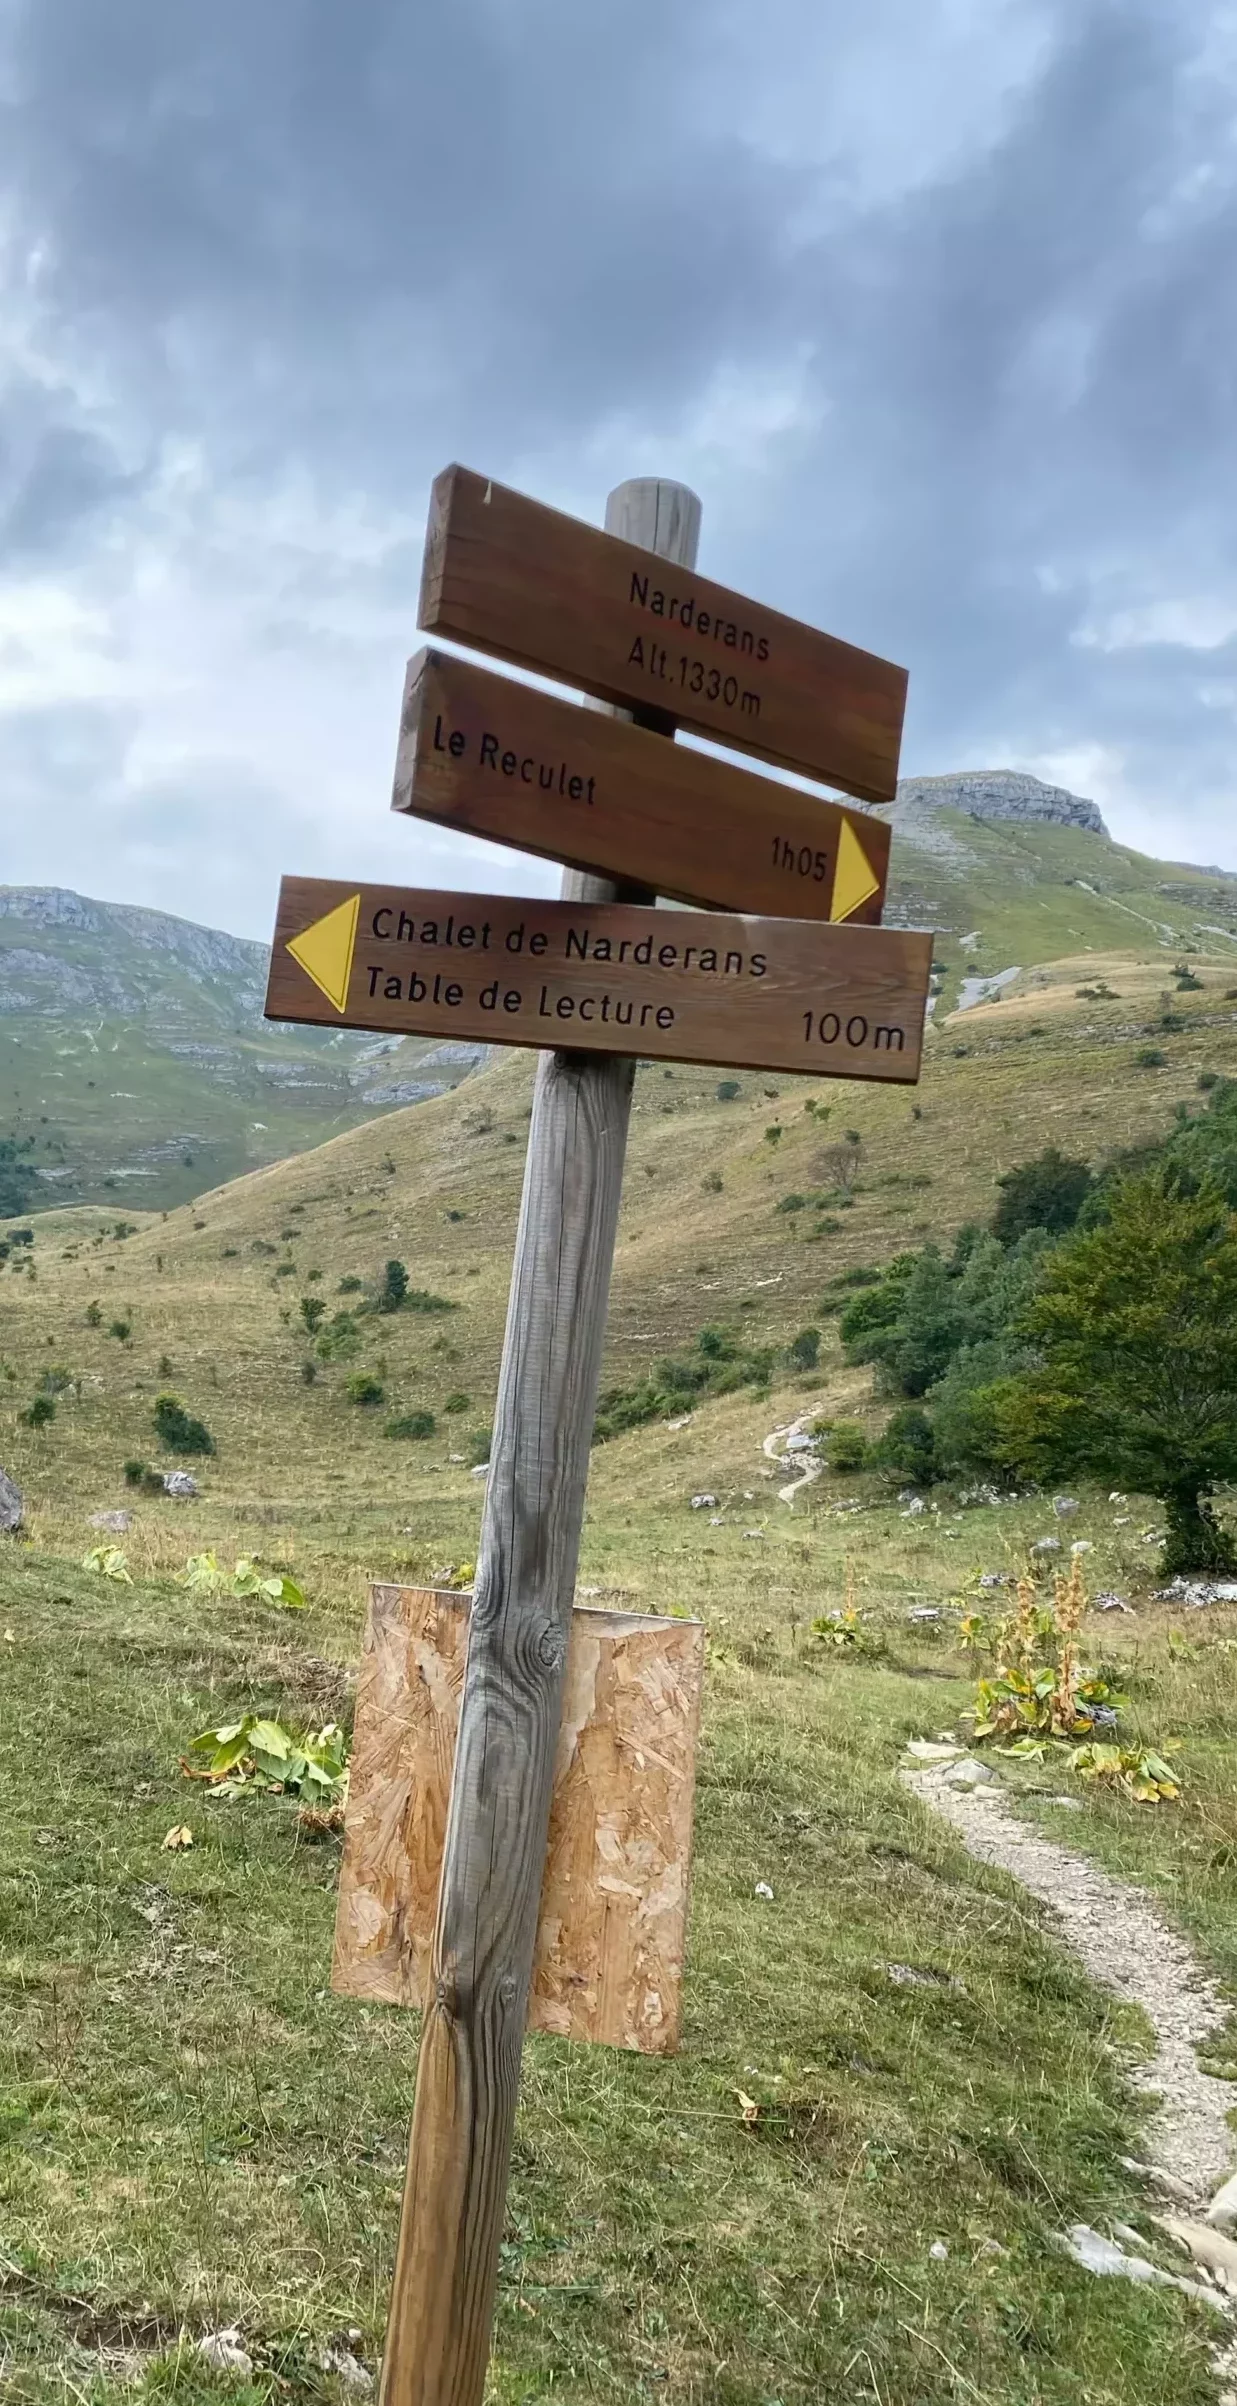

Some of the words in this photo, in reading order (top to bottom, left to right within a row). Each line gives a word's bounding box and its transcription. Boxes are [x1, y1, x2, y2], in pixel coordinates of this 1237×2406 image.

[629, 572, 770, 661] Narderans
[433, 715, 466, 757] Le
[480, 732, 597, 805] Reculet
[770, 836, 828, 882] 1h05
[371, 908, 492, 950] Chalet
[505, 923, 549, 957] de
[565, 929, 768, 977] Narderans
[366, 966, 464, 1007] Table
[478, 979, 522, 1014] de
[538, 985, 676, 1030] Lecture
[801, 1010, 906, 1052] 100m
